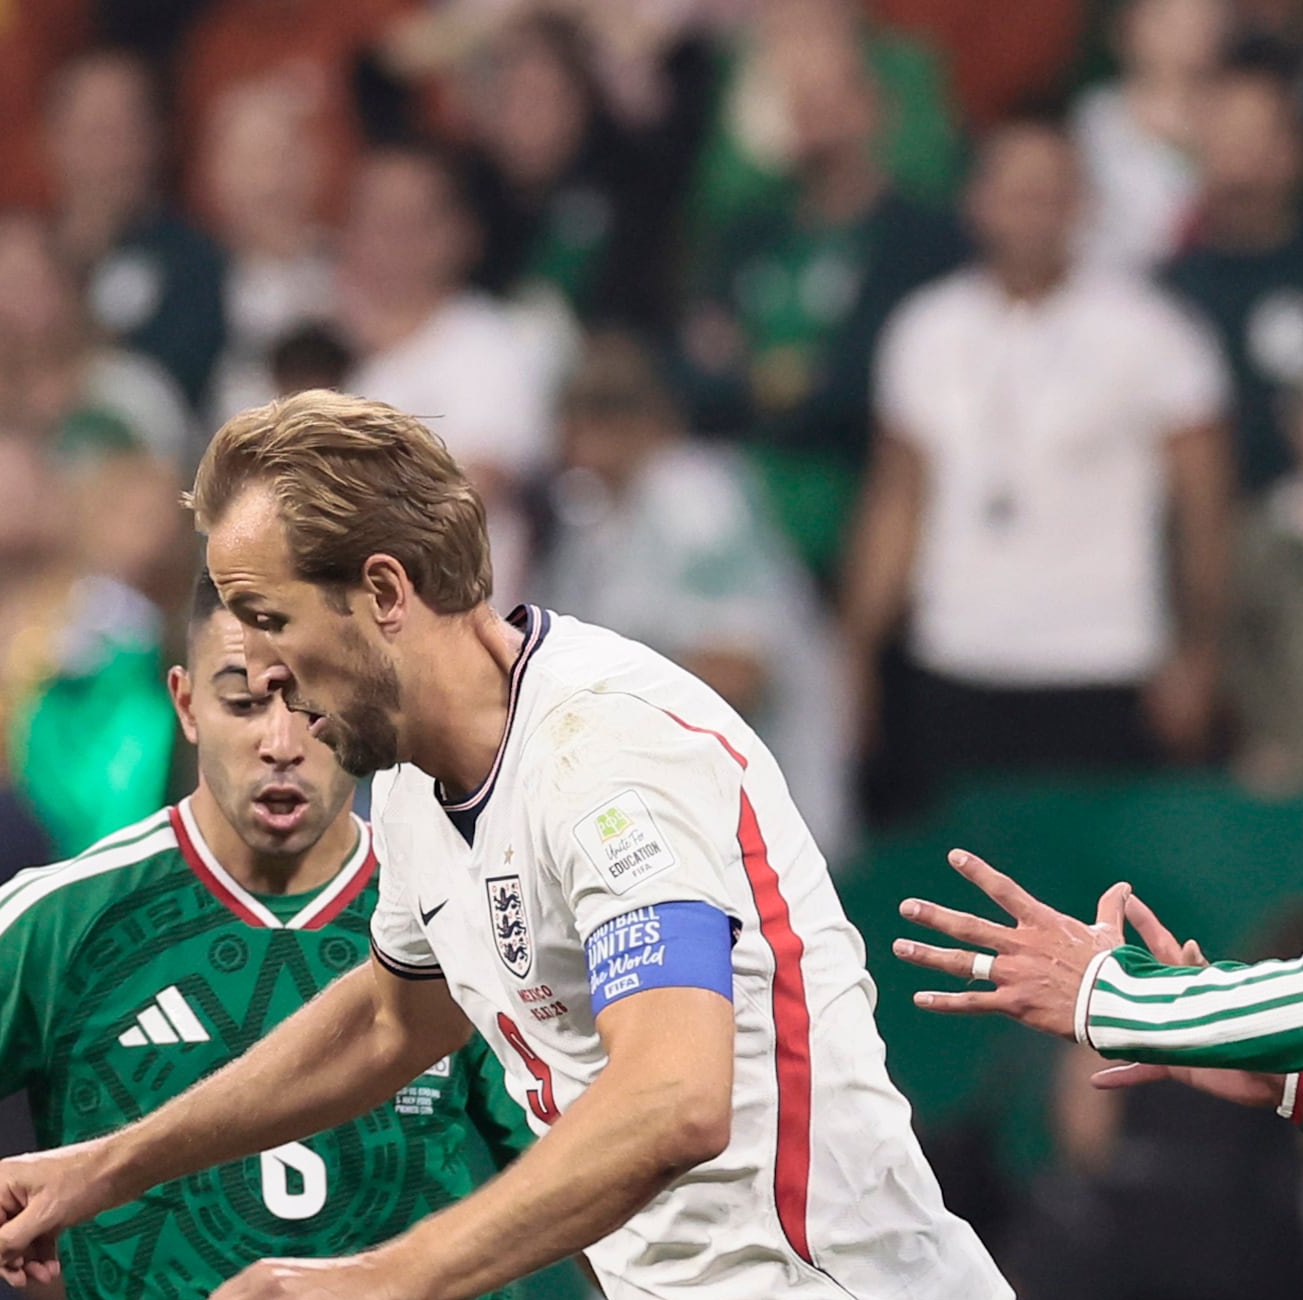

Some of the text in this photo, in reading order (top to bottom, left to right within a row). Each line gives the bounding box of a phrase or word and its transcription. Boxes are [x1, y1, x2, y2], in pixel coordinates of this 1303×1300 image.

[608, 840, 662, 878] EDUCATION
[588, 920, 661, 971] UNITES
[607, 944, 666, 978] World
[606, 977, 638, 997] FIFA
[259, 1140, 328, 1220] 6
